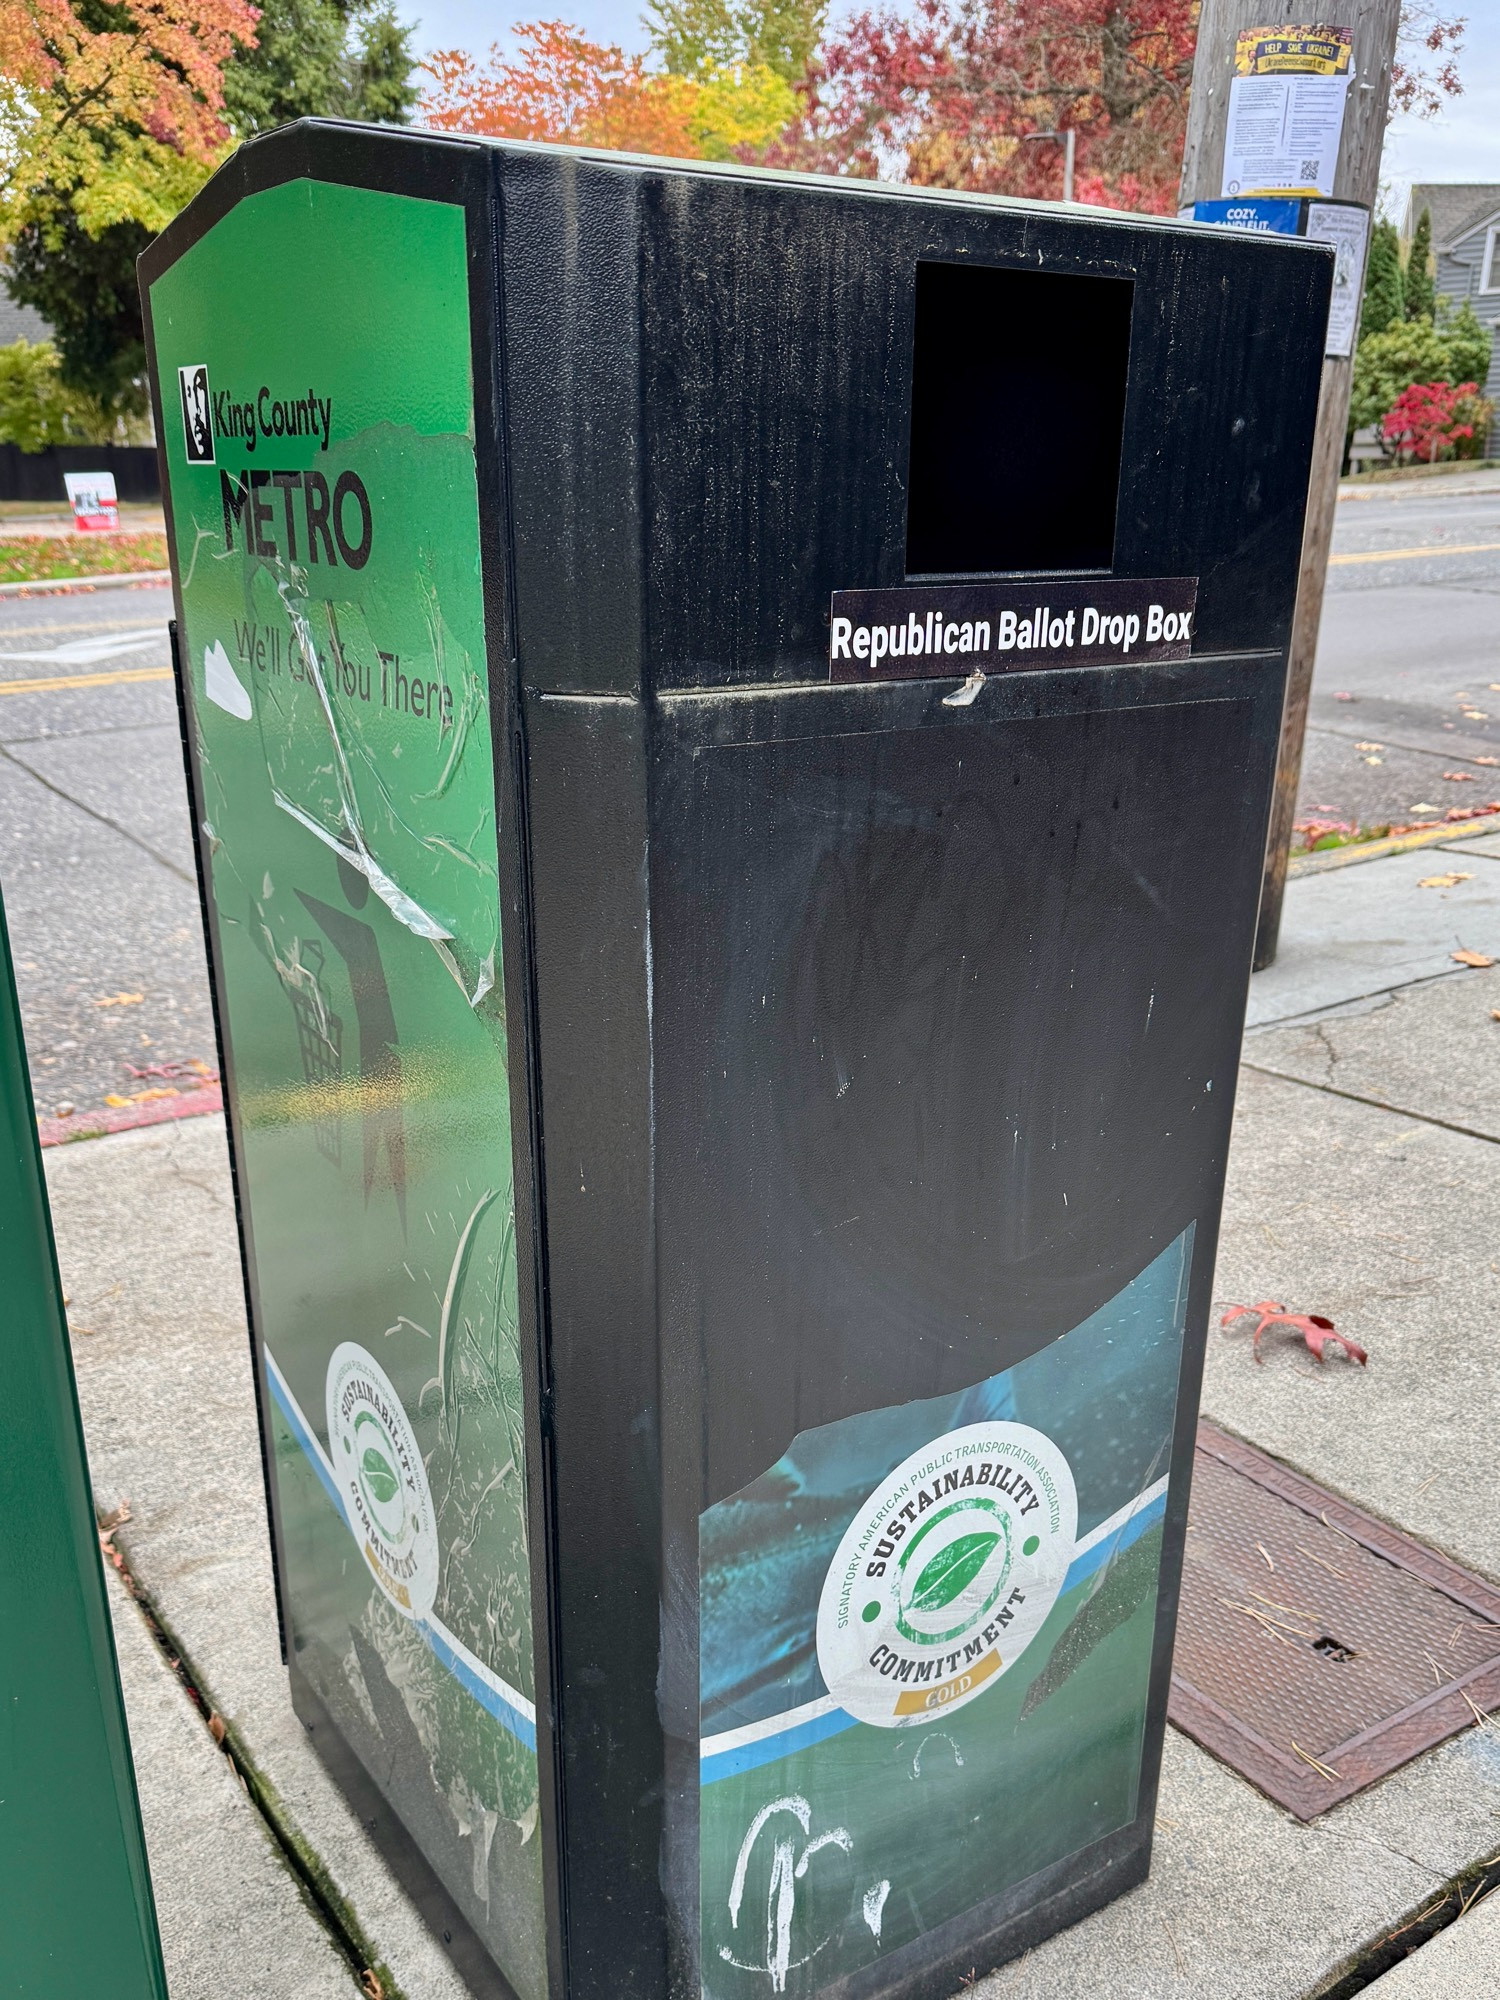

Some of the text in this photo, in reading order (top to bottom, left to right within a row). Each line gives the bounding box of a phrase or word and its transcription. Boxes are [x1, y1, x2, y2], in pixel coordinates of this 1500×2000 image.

[1265, 42, 1282, 53] HELP
[1287, 43, 1303, 53] SAVE
[1226, 208, 1258, 220] COZY.
[213, 386, 331, 452] King County
[220, 469, 373, 571] METRO
[234, 619, 280, 676] We'll
[376, 650, 453, 724] There
[831, 605, 1192, 668] Republican Ballot Drop Box
[341, 1379, 416, 1492] SUSTAINABILITY
[838, 1441, 1060, 1629] SIGNATORY AMERICAN PUBLIC TRANSPORTATION ASSOCIATION
[866, 1463, 1040, 1578] SUSTAINABILITY
[869, 1587, 1026, 1683] COMMITMENT
[925, 1675, 972, 1708] GOLD
